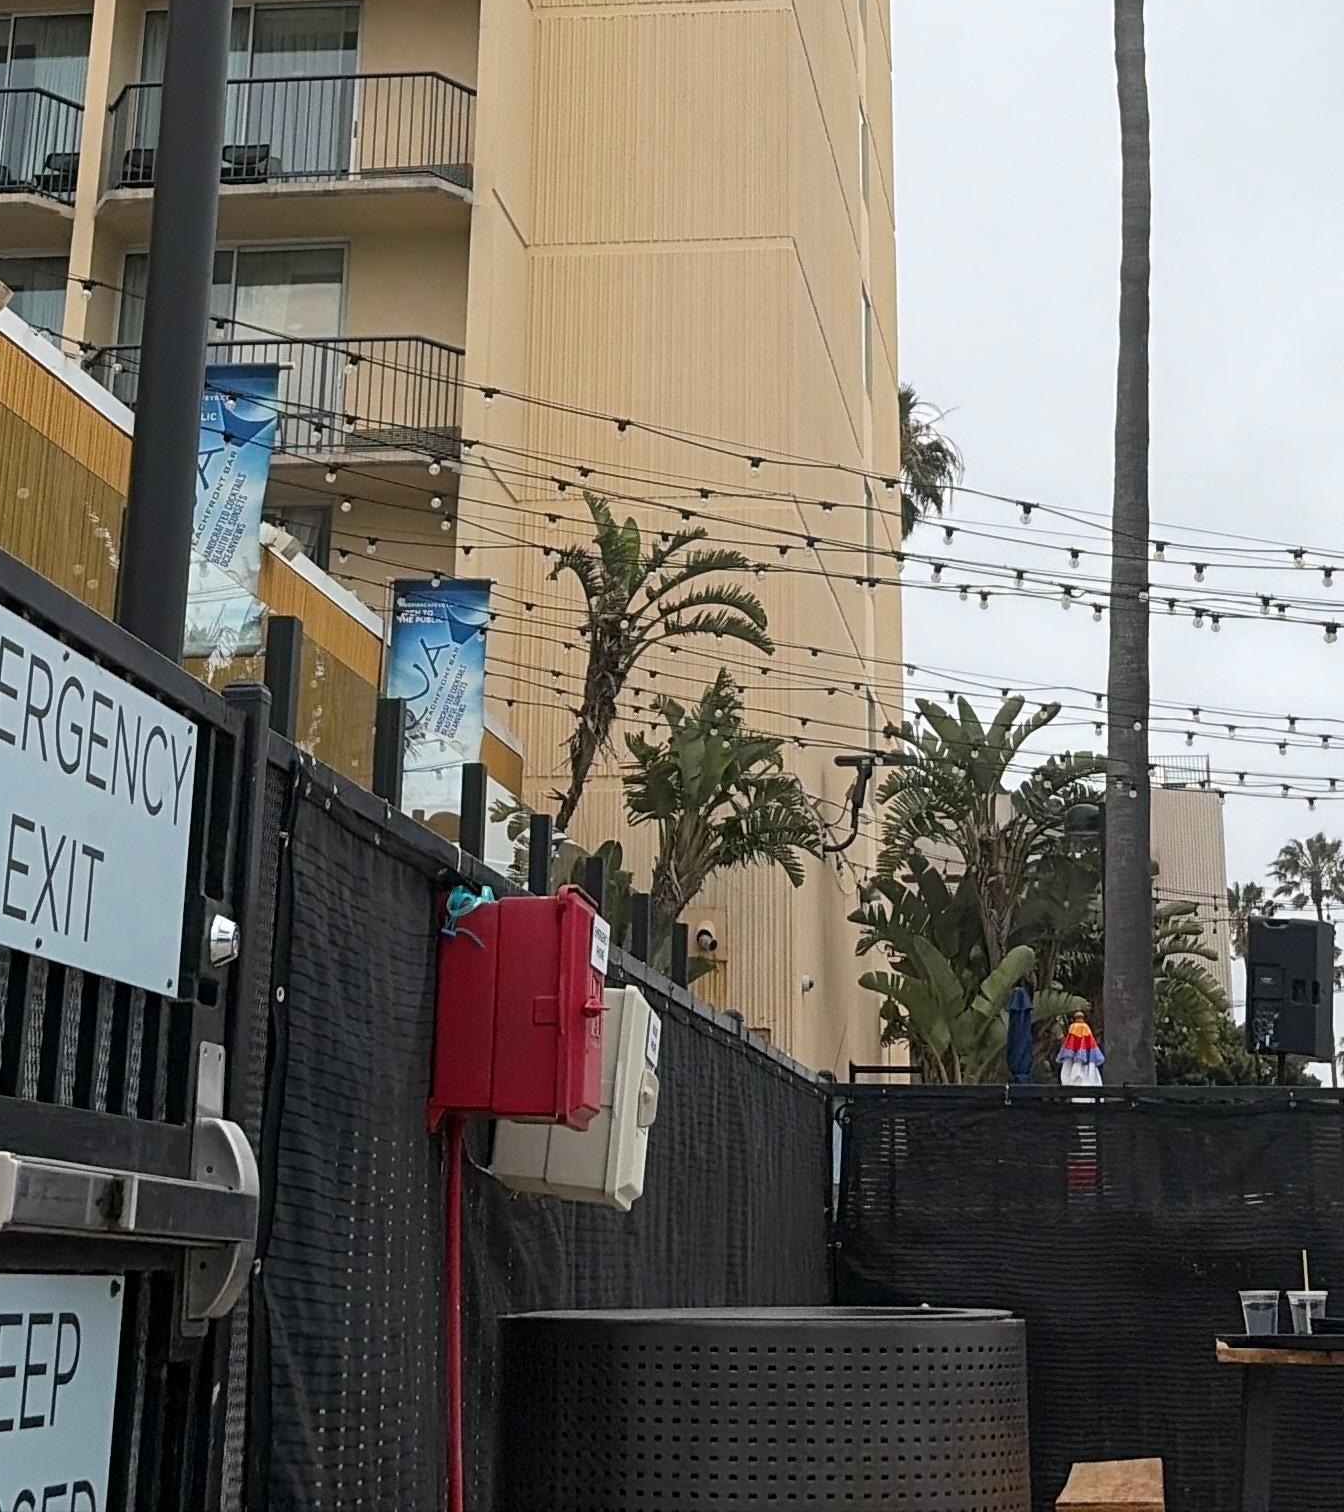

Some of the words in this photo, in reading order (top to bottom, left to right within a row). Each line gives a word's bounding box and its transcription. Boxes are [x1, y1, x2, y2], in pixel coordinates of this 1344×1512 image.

[200, 412, 218, 422] LIC
[193, 475, 227, 550] EACHFRONT
[1, 813, 105, 943] EXIT
